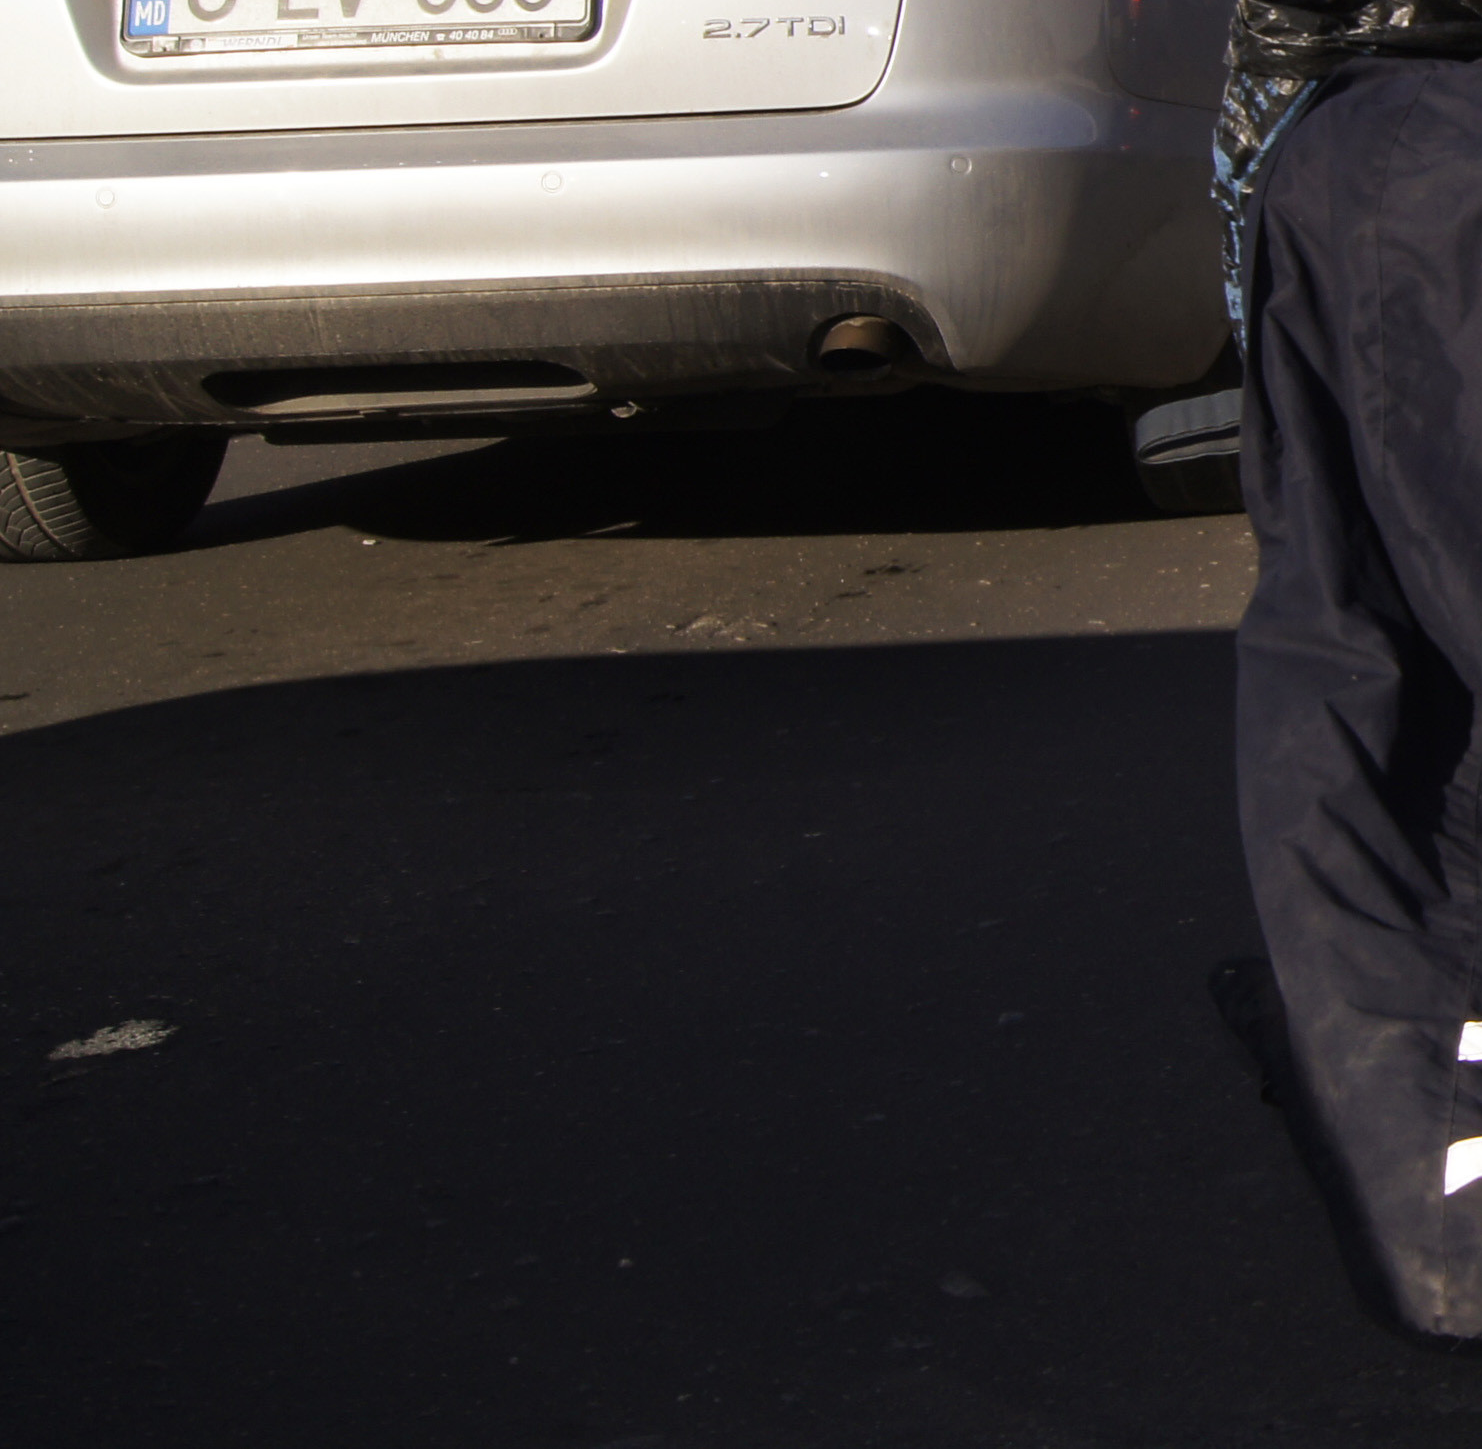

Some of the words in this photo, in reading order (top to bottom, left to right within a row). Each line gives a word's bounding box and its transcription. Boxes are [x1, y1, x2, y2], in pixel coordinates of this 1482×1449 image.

[371, 31, 430, 43] MÜNCHEN
[449, 30, 463, 41] 40
[465, 30, 479, 40] 40
